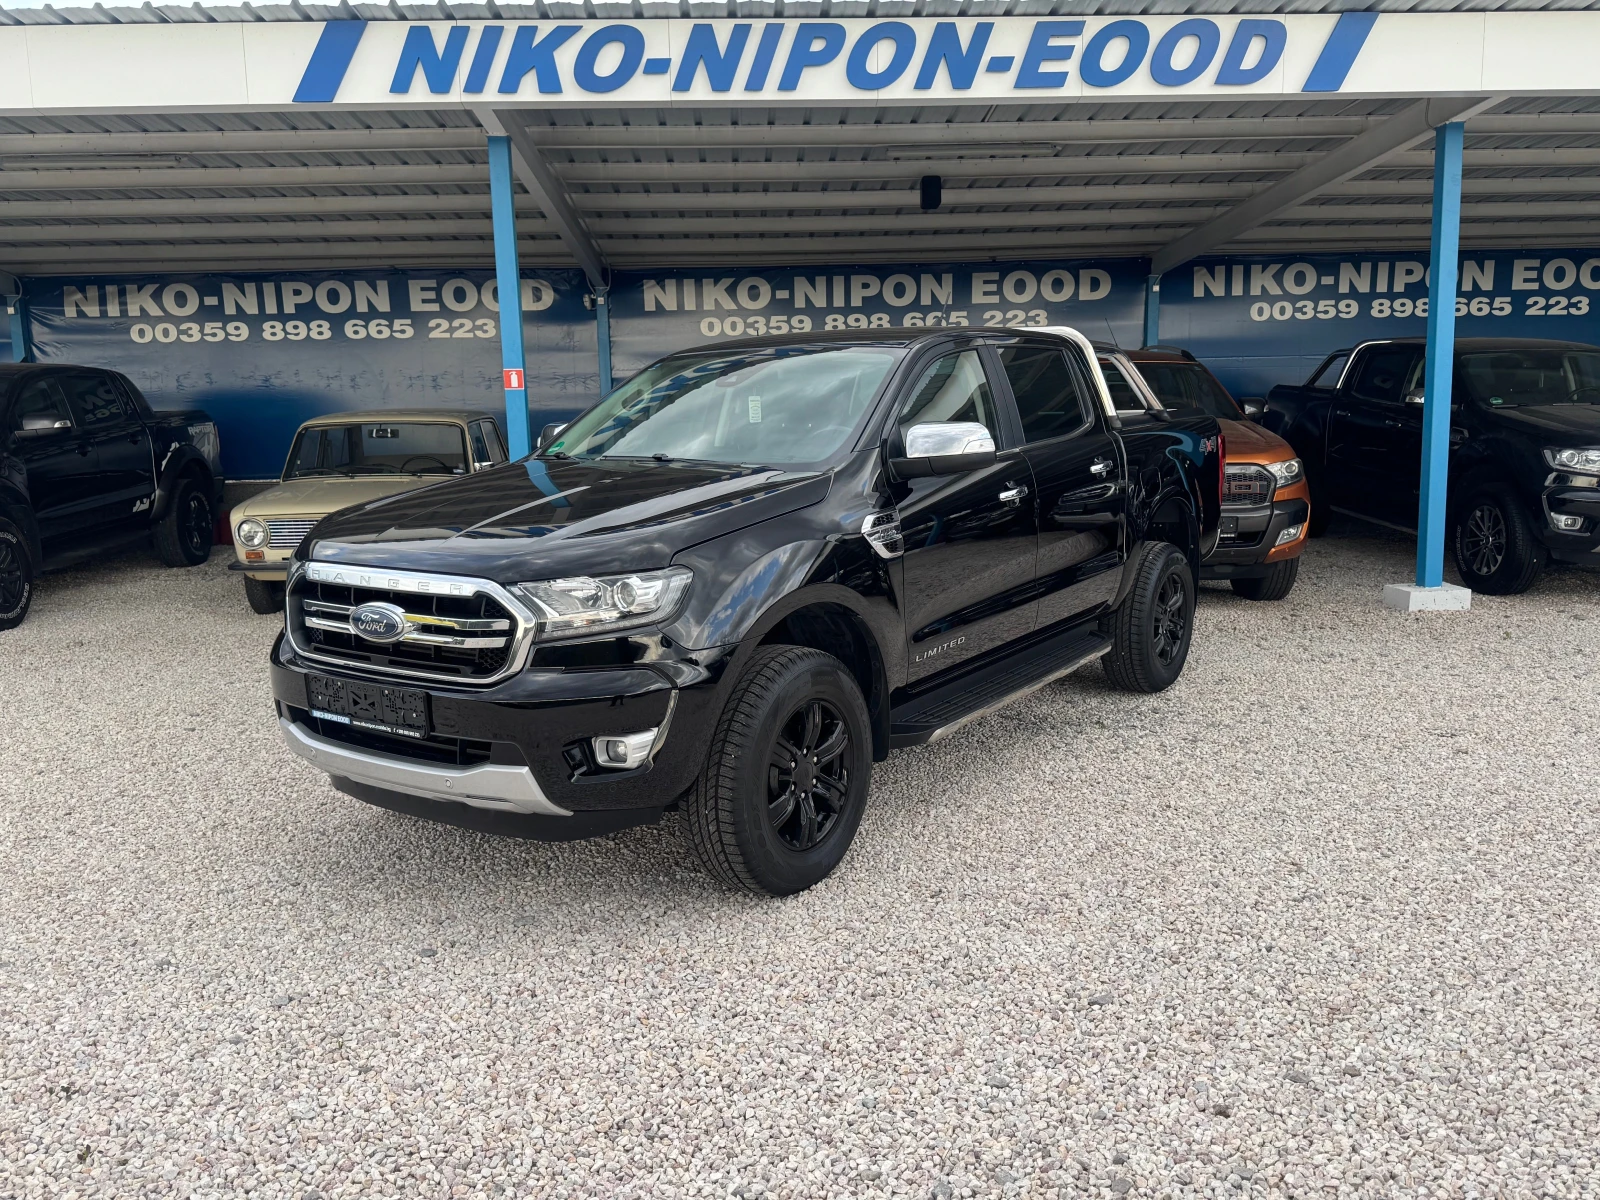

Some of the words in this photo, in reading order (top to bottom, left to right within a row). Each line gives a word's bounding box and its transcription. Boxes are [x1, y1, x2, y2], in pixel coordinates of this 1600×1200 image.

[389, 18, 1288, 94] NIKO-NIPON-EOOD
[643, 273, 953, 312] NIKO-NIPON
[971, 269, 1112, 305] EOOD
[1193, 259, 1495, 298] NIKO-NIPN
[63, 279, 391, 318] NIKO-NIPON
[1250, 299, 1359, 322] 00359
[1370, 298, 1429, 318] 898
[1454, 296, 1513, 317] 665
[1525, 296, 1590, 316] 223
[130, 321, 249, 344] 00359
[262, 320, 332, 342] 898
[344, 318, 415, 340] 665
[428, 318, 497, 339] 223
[700, 315, 812, 337] 00359
[824, 313, 890, 331] 898
[983, 309, 1048, 327] 223
[311, 568, 464, 595] RANGER
[358, 612, 387, 633] Ford
[915, 636, 966, 662] LIMITED
